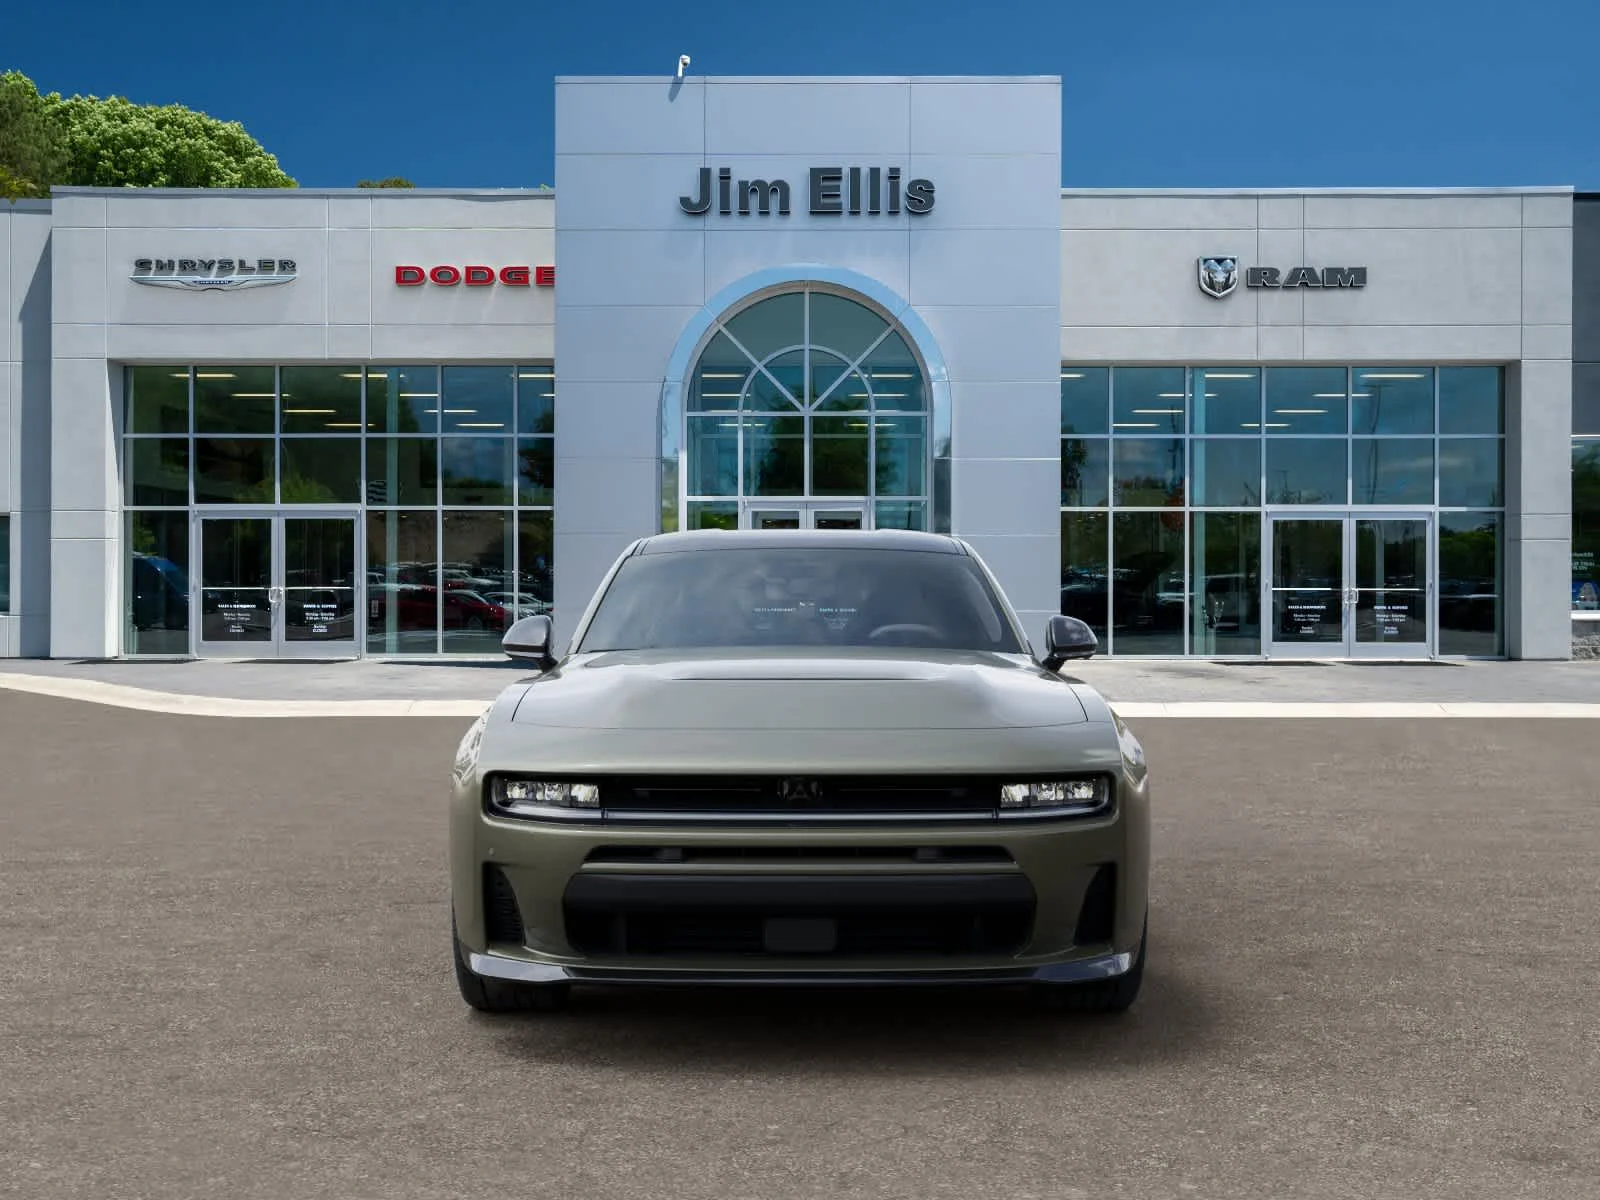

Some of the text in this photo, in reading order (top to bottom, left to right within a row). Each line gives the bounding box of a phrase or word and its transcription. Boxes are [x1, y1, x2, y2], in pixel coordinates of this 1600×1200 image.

[679, 167, 936, 214] Jim Ellis
[134, 258, 297, 272] CHRYSLER
[395, 265, 555, 287] DODGE
[1247, 266, 1367, 288] RAM
